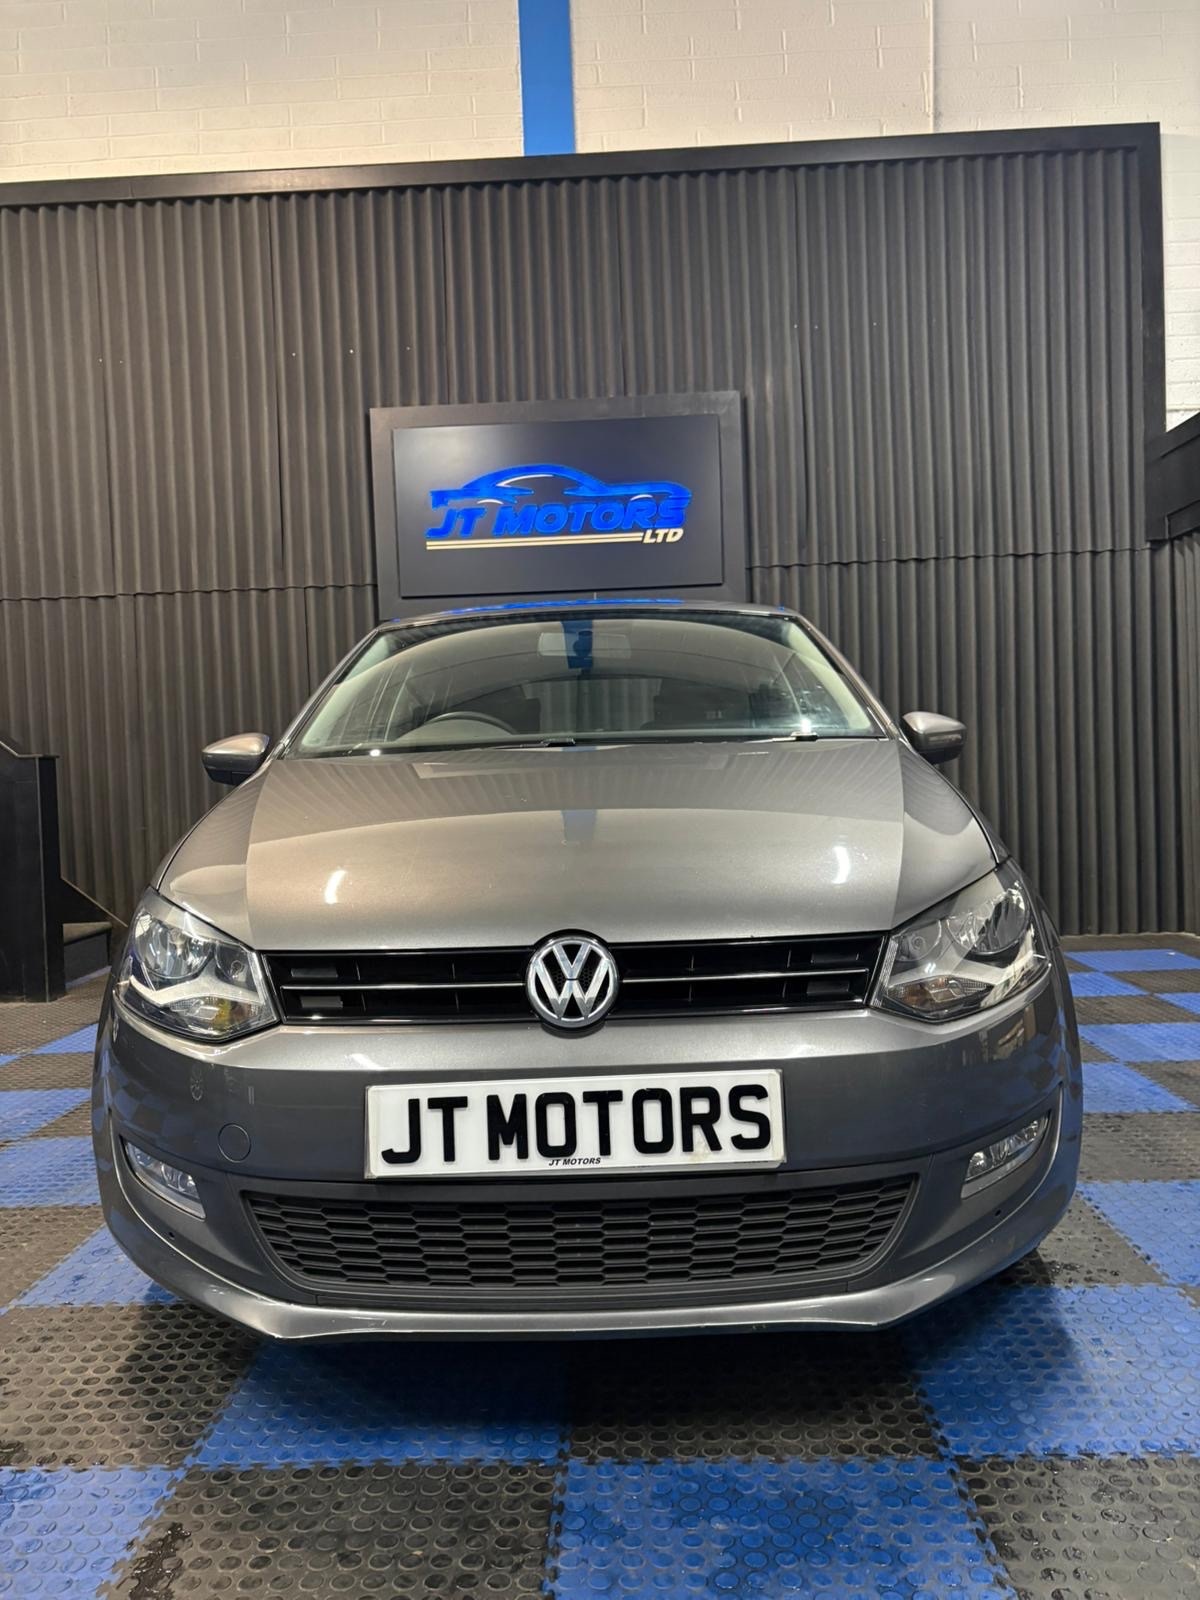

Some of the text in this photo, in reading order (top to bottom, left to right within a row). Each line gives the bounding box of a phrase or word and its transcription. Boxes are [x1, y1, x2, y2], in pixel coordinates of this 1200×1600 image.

[425, 498, 691, 538] JT MOTORS
[642, 528, 684, 544] LTD
[381, 1084, 771, 1164] JT MOTORS
[562, 1157, 601, 1166] MOTORS
